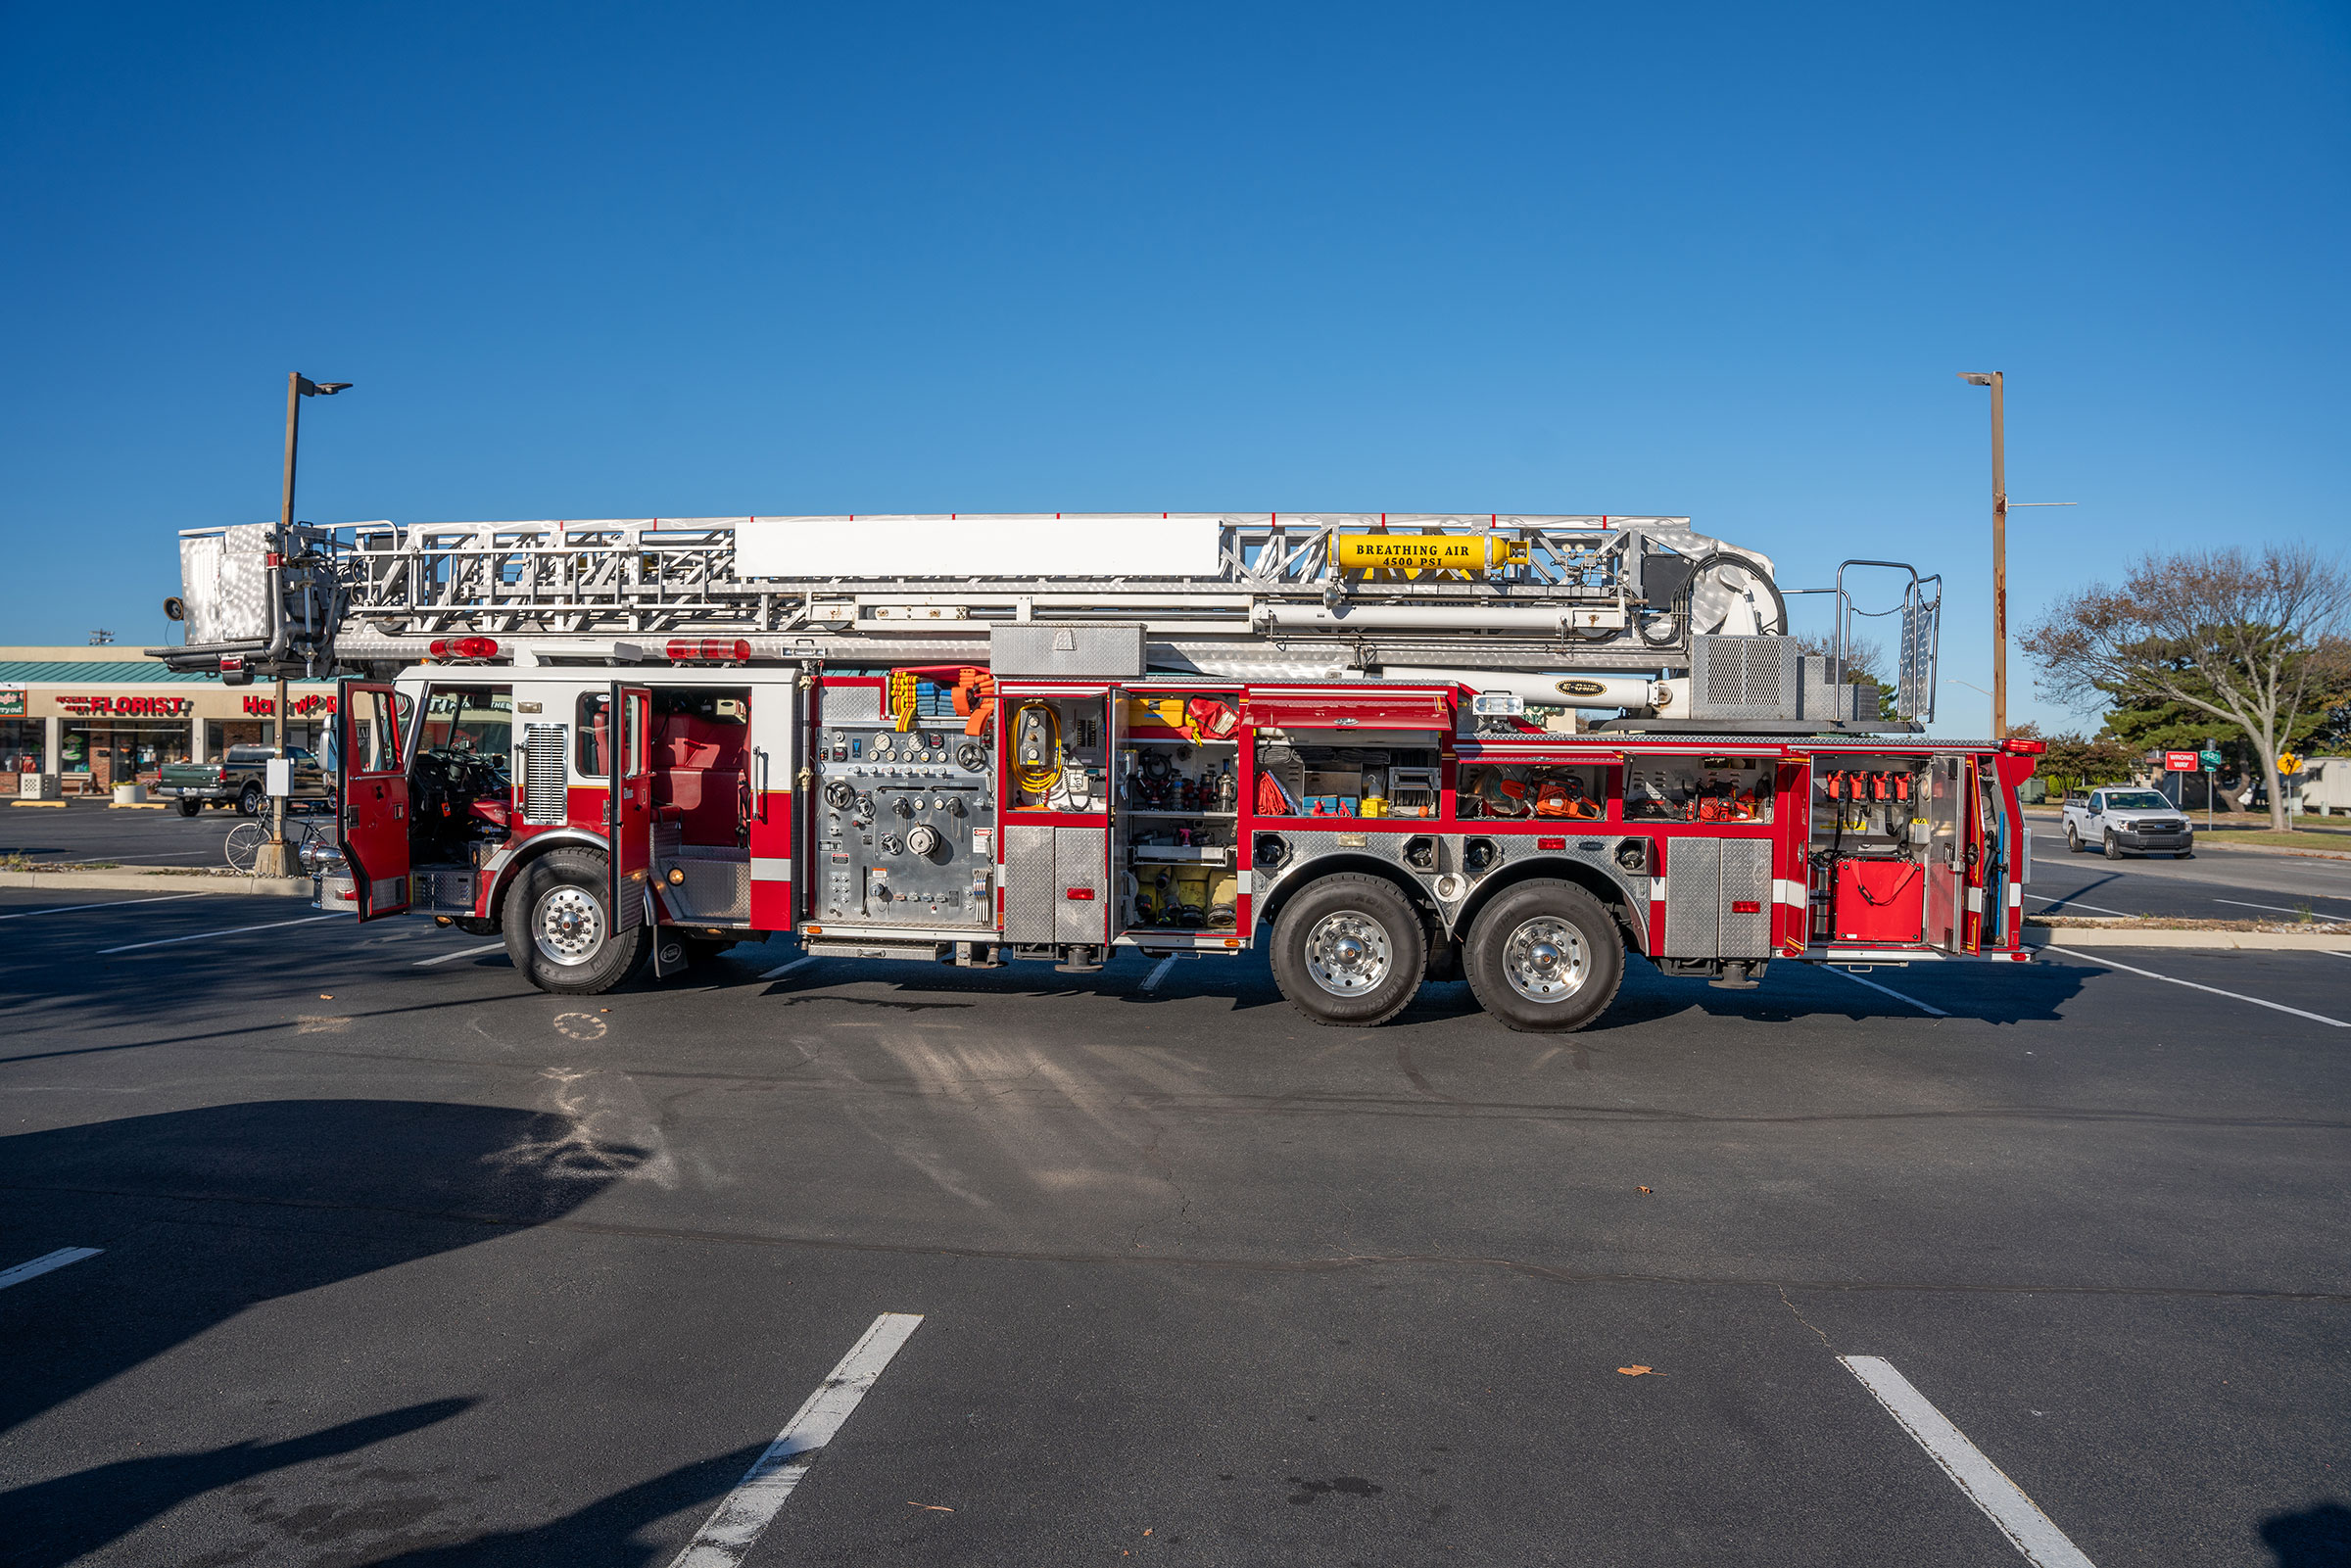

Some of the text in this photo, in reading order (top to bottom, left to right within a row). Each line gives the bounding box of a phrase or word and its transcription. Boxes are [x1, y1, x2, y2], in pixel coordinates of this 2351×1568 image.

[1357, 545, 1469, 556] BREATHING AIR
[1383, 557, 1442, 566] 4500 PSI
[90, 696, 183, 713] FLORIST
